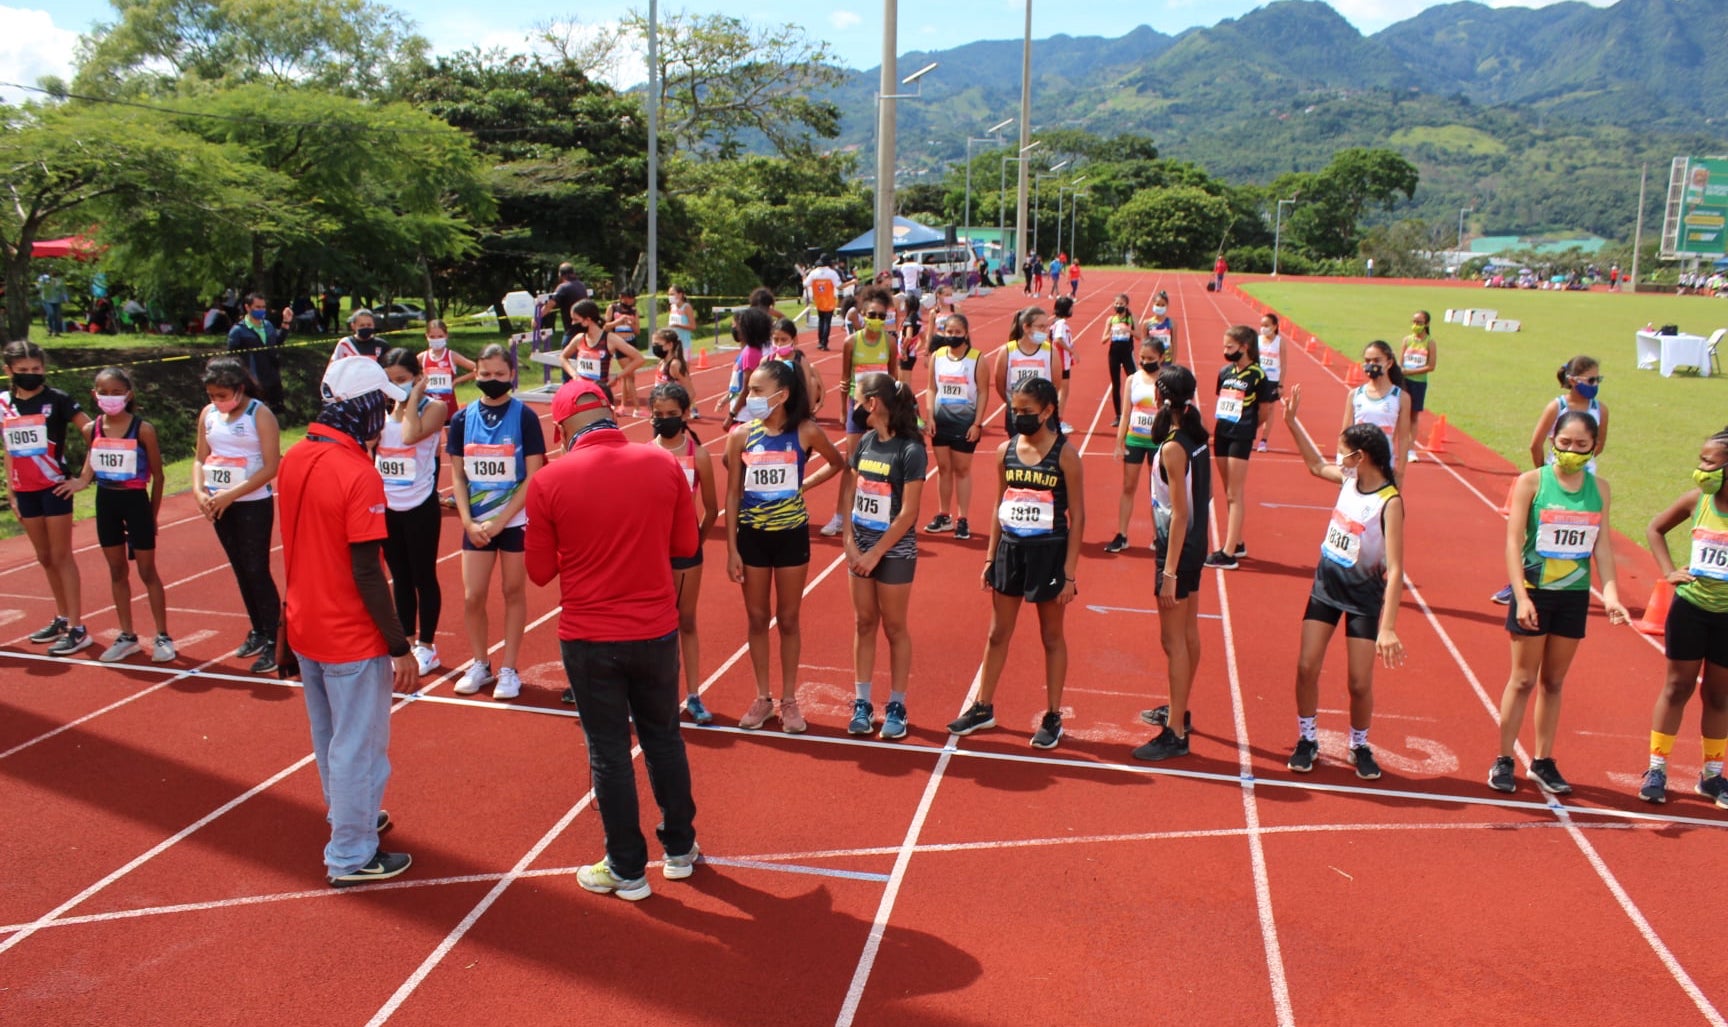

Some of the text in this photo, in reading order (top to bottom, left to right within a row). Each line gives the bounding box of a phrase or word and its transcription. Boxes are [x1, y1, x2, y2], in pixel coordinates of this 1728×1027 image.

[1018, 369, 1039, 379] 1828
[943, 384, 961, 395] 1827
[1137, 415, 1153, 426] 180
[8, 429, 39, 445] 1905
[99, 453, 124, 468] 1187
[472, 461, 506, 475] 1304
[753, 469, 786, 485] 1887
[1553, 529, 1586, 546] 1761
[1701, 546, 1728, 567] 176
